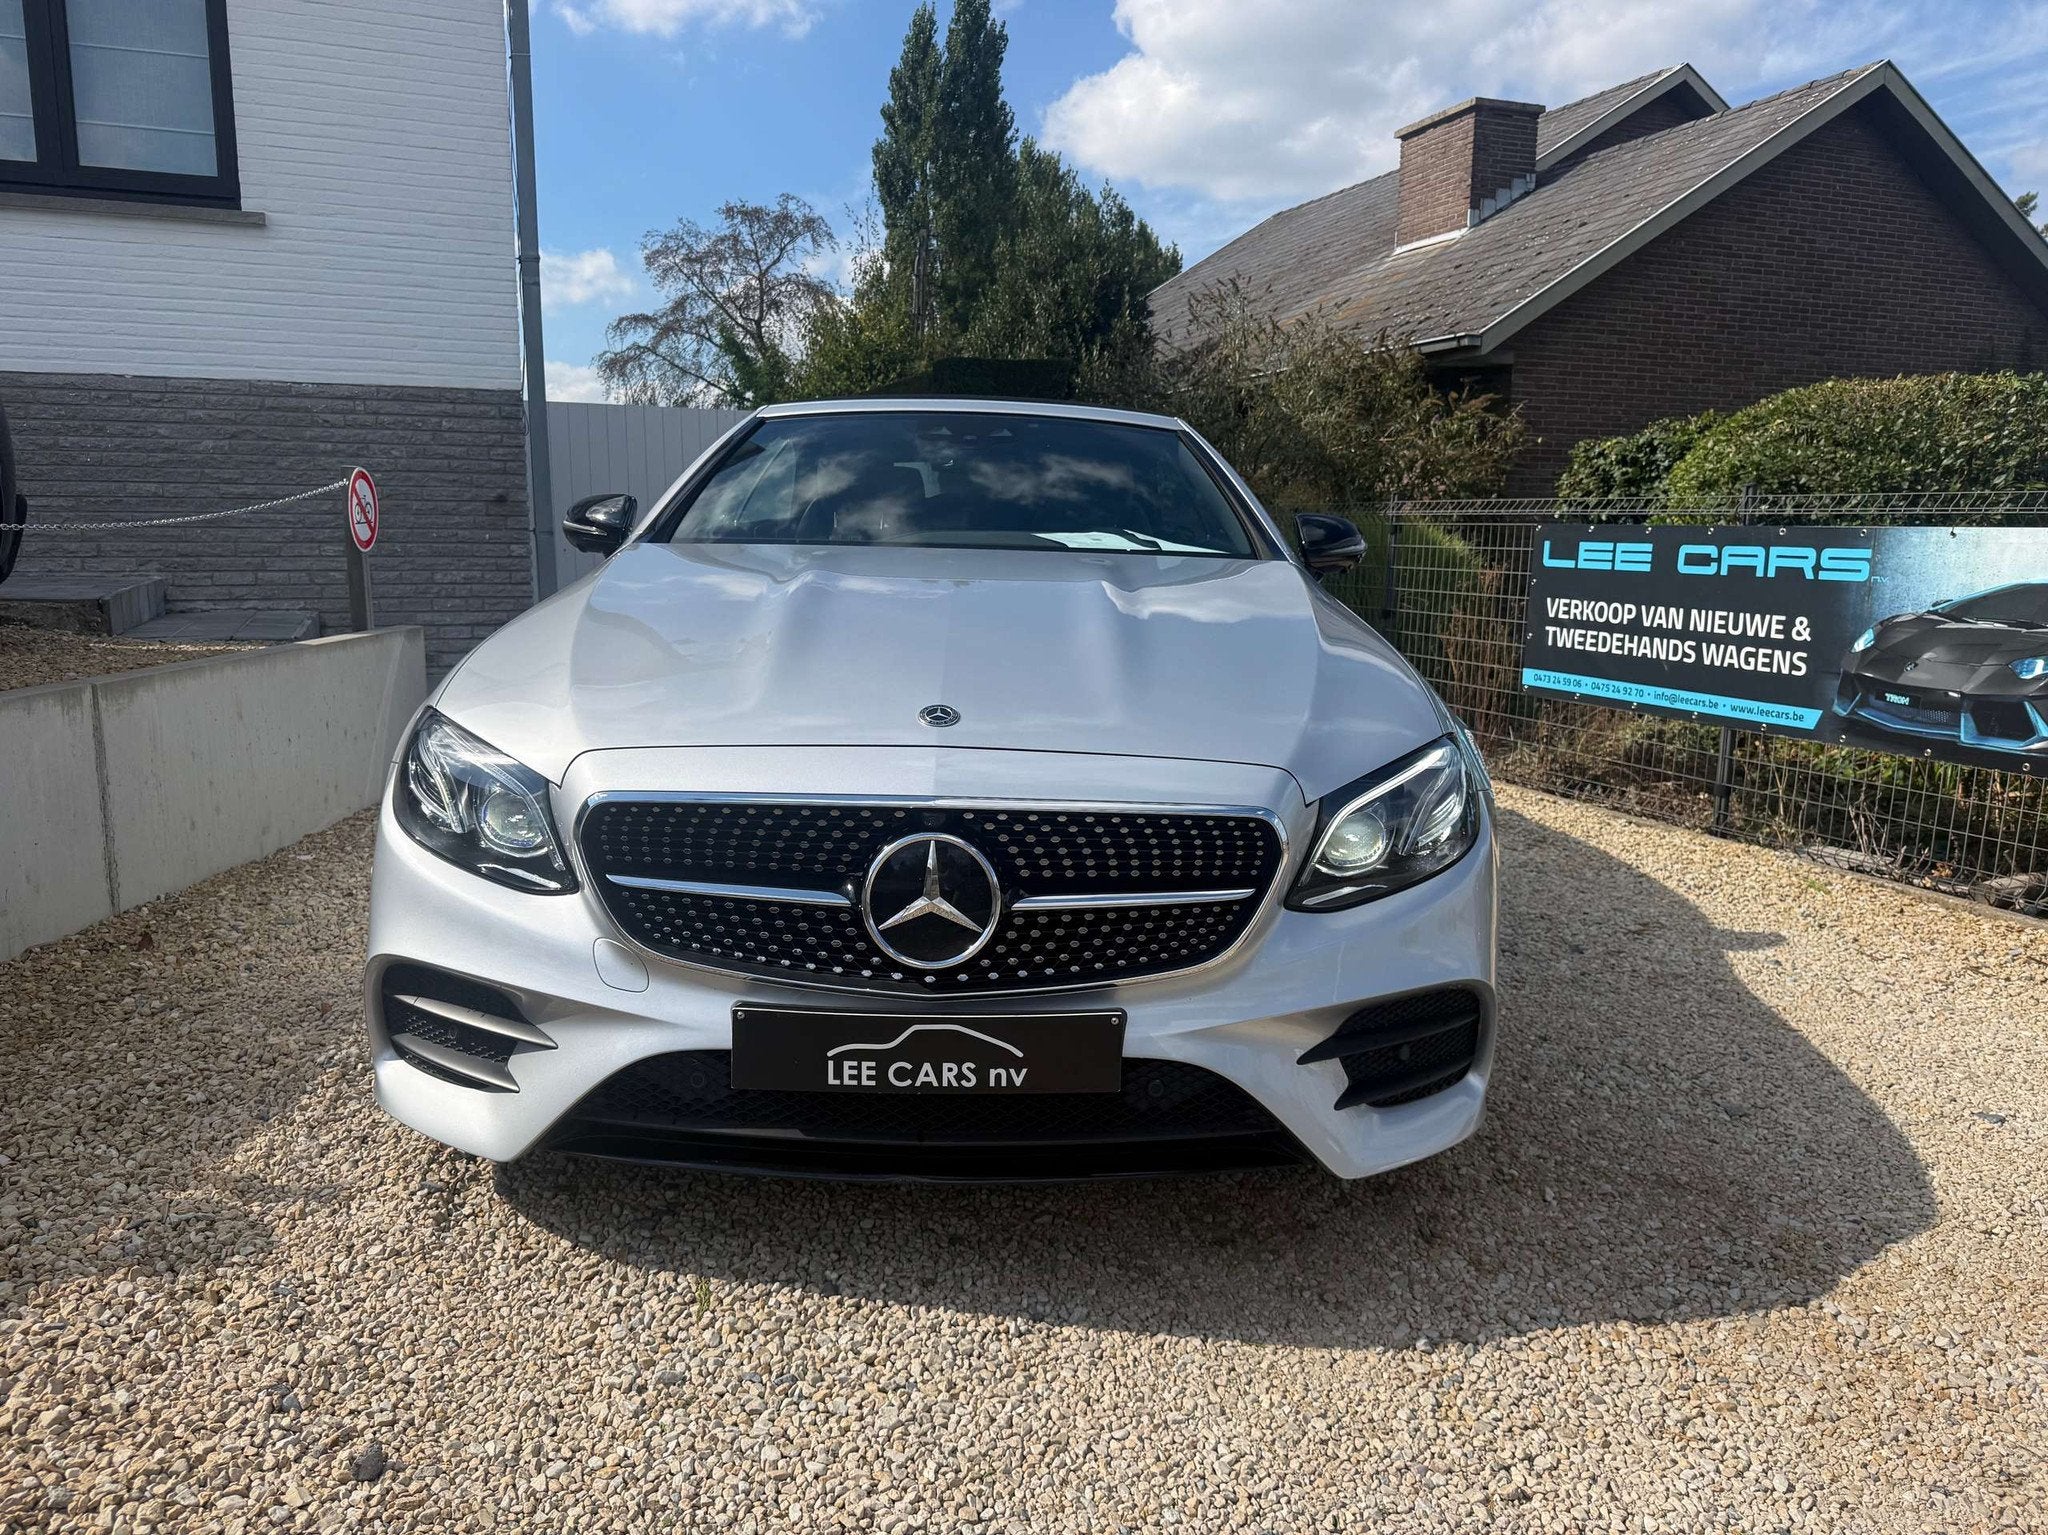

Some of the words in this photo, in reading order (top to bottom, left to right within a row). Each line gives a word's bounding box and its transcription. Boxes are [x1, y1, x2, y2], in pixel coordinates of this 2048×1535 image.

[1543, 540, 1653, 572] LEE
[1677, 544, 1872, 582] CARS
[1546, 597, 1636, 626] VERKOOP
[1641, 605, 1684, 630] VAN
[1689, 608, 1786, 640] NIEUWE
[1791, 616, 1812, 642] &
[1545, 625, 1696, 664] TWEEDEHANDS
[1701, 643, 1808, 677] WAGENS
[1533, 673, 1551, 684] 0473
[1552, 677, 1561, 685] 24
[1562, 679, 1572, 687] 59
[1572, 680, 1582, 688] 06
[1590, 683, 1610, 693] 0475
[1611, 685, 1621, 694] 24
[1622, 687, 1632, 696] 92
[1634, 688, 1644, 698] 70
[1653, 690, 1719, 710] info@leecars.be
[1730, 703, 1805, 723] www.leecars.be
[827, 1060, 876, 1087] LEE
[887, 1061, 977, 1088] CARS
[989, 1068, 1028, 1088] nv
